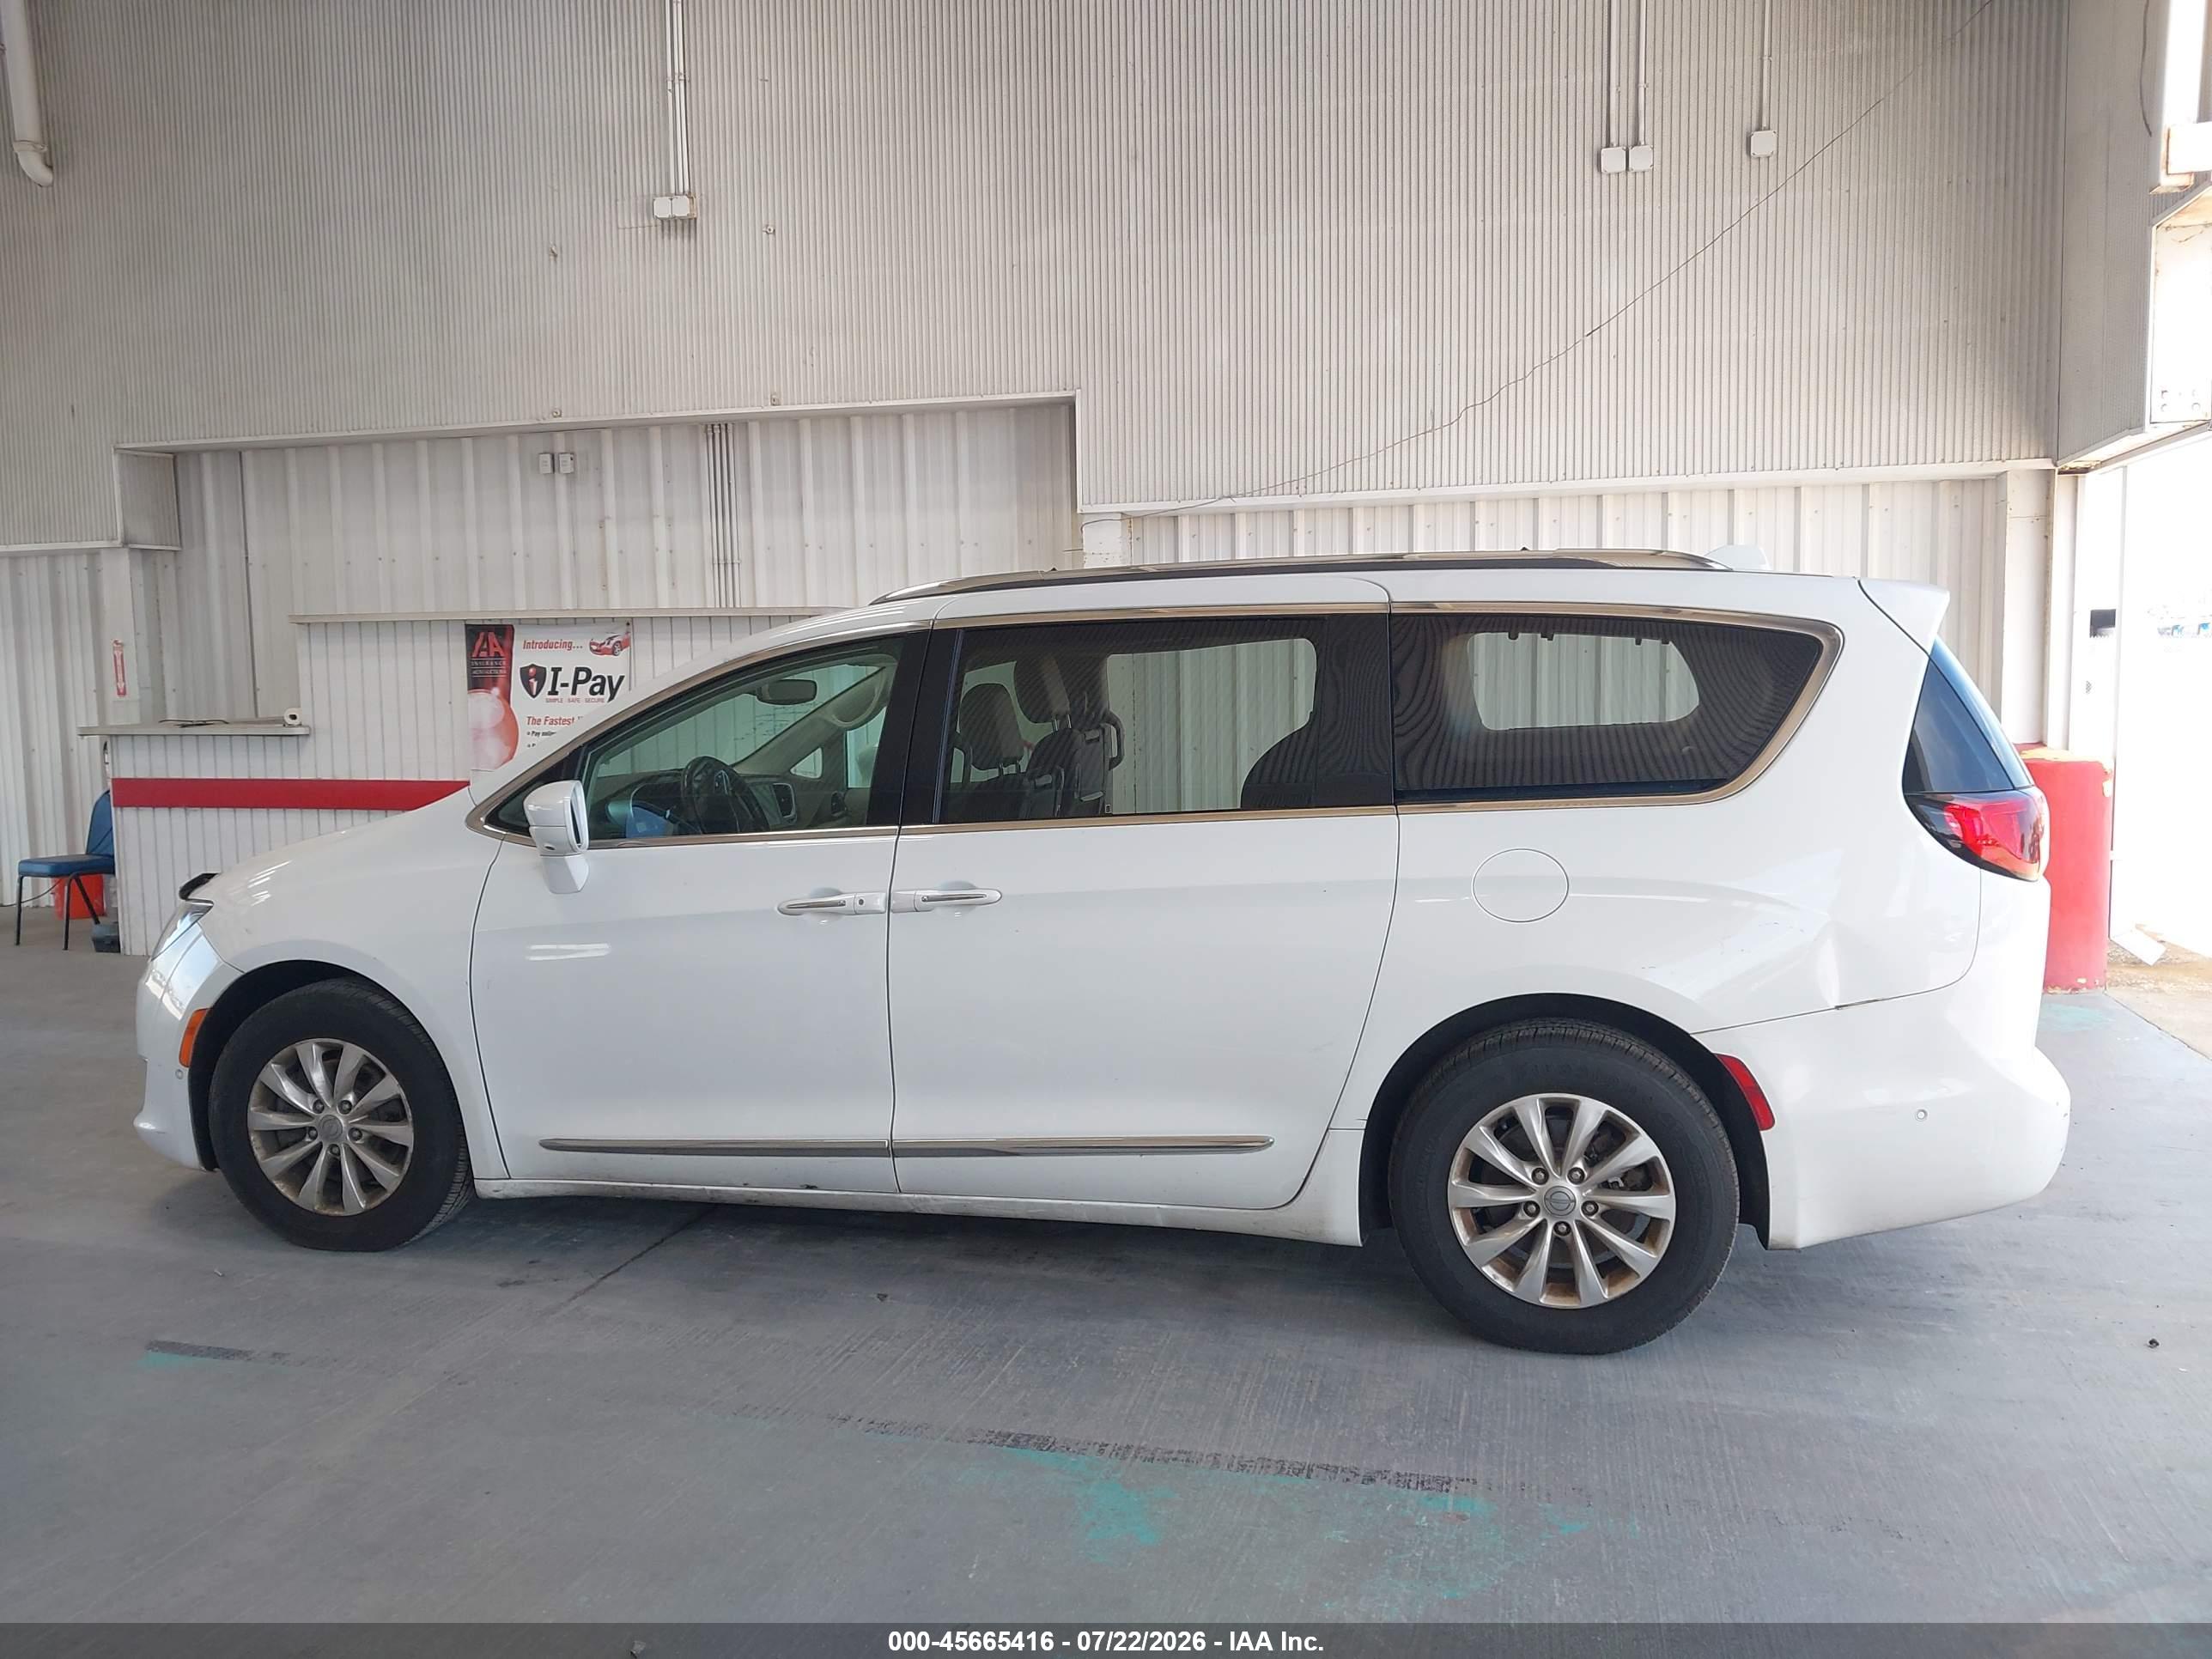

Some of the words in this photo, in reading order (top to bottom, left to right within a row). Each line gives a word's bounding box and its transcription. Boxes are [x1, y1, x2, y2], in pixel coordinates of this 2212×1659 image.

[522, 638, 583, 651] Introducing...
[547, 666, 625, 703] I-Pay
[526, 715, 542, 726] The
